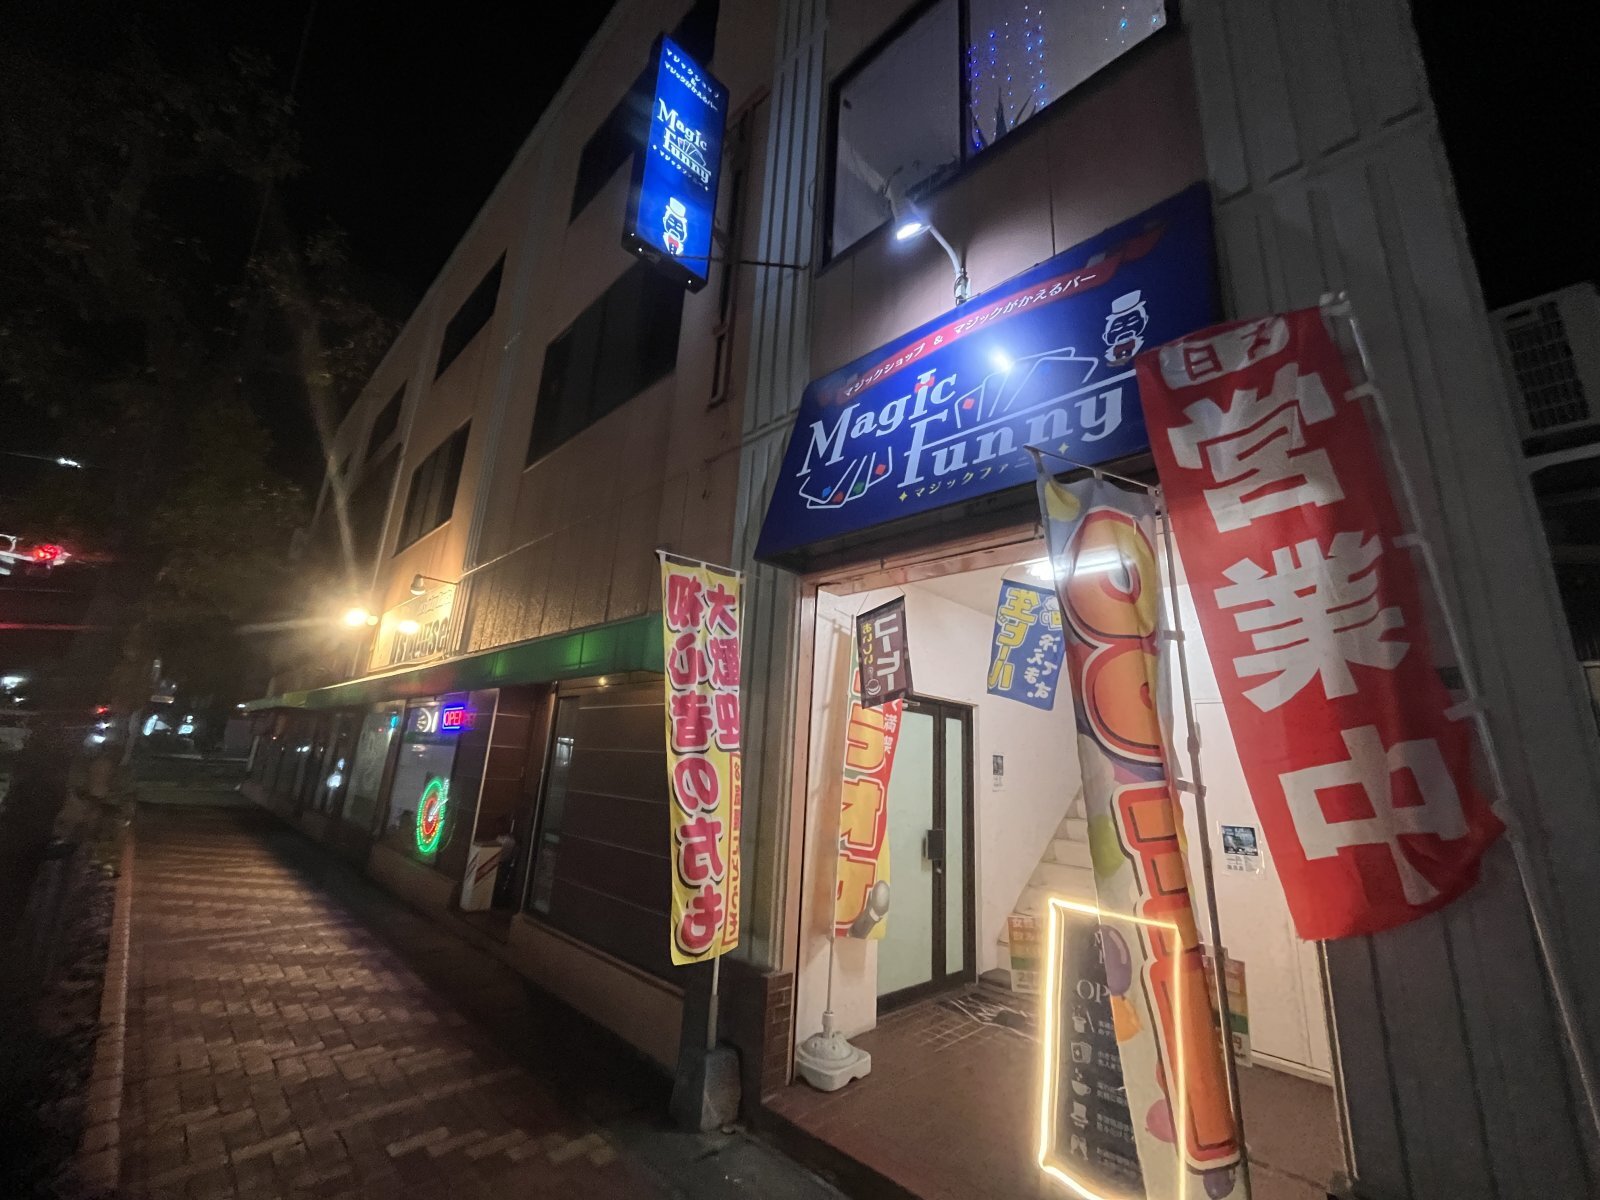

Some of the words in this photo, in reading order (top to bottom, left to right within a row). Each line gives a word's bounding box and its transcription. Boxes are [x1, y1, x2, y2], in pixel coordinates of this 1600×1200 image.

[656, 98, 707, 151] Magic
[663, 128, 711, 183] Funny
[844, 342, 927, 396] マジックショップ
[933, 335, 944, 345] &
[954, 273, 1097, 334] マジックがかえるバー
[796, 368, 958, 477] Magic
[897, 380, 1128, 488] Funny
[835, 671, 886, 927] ラオケ
